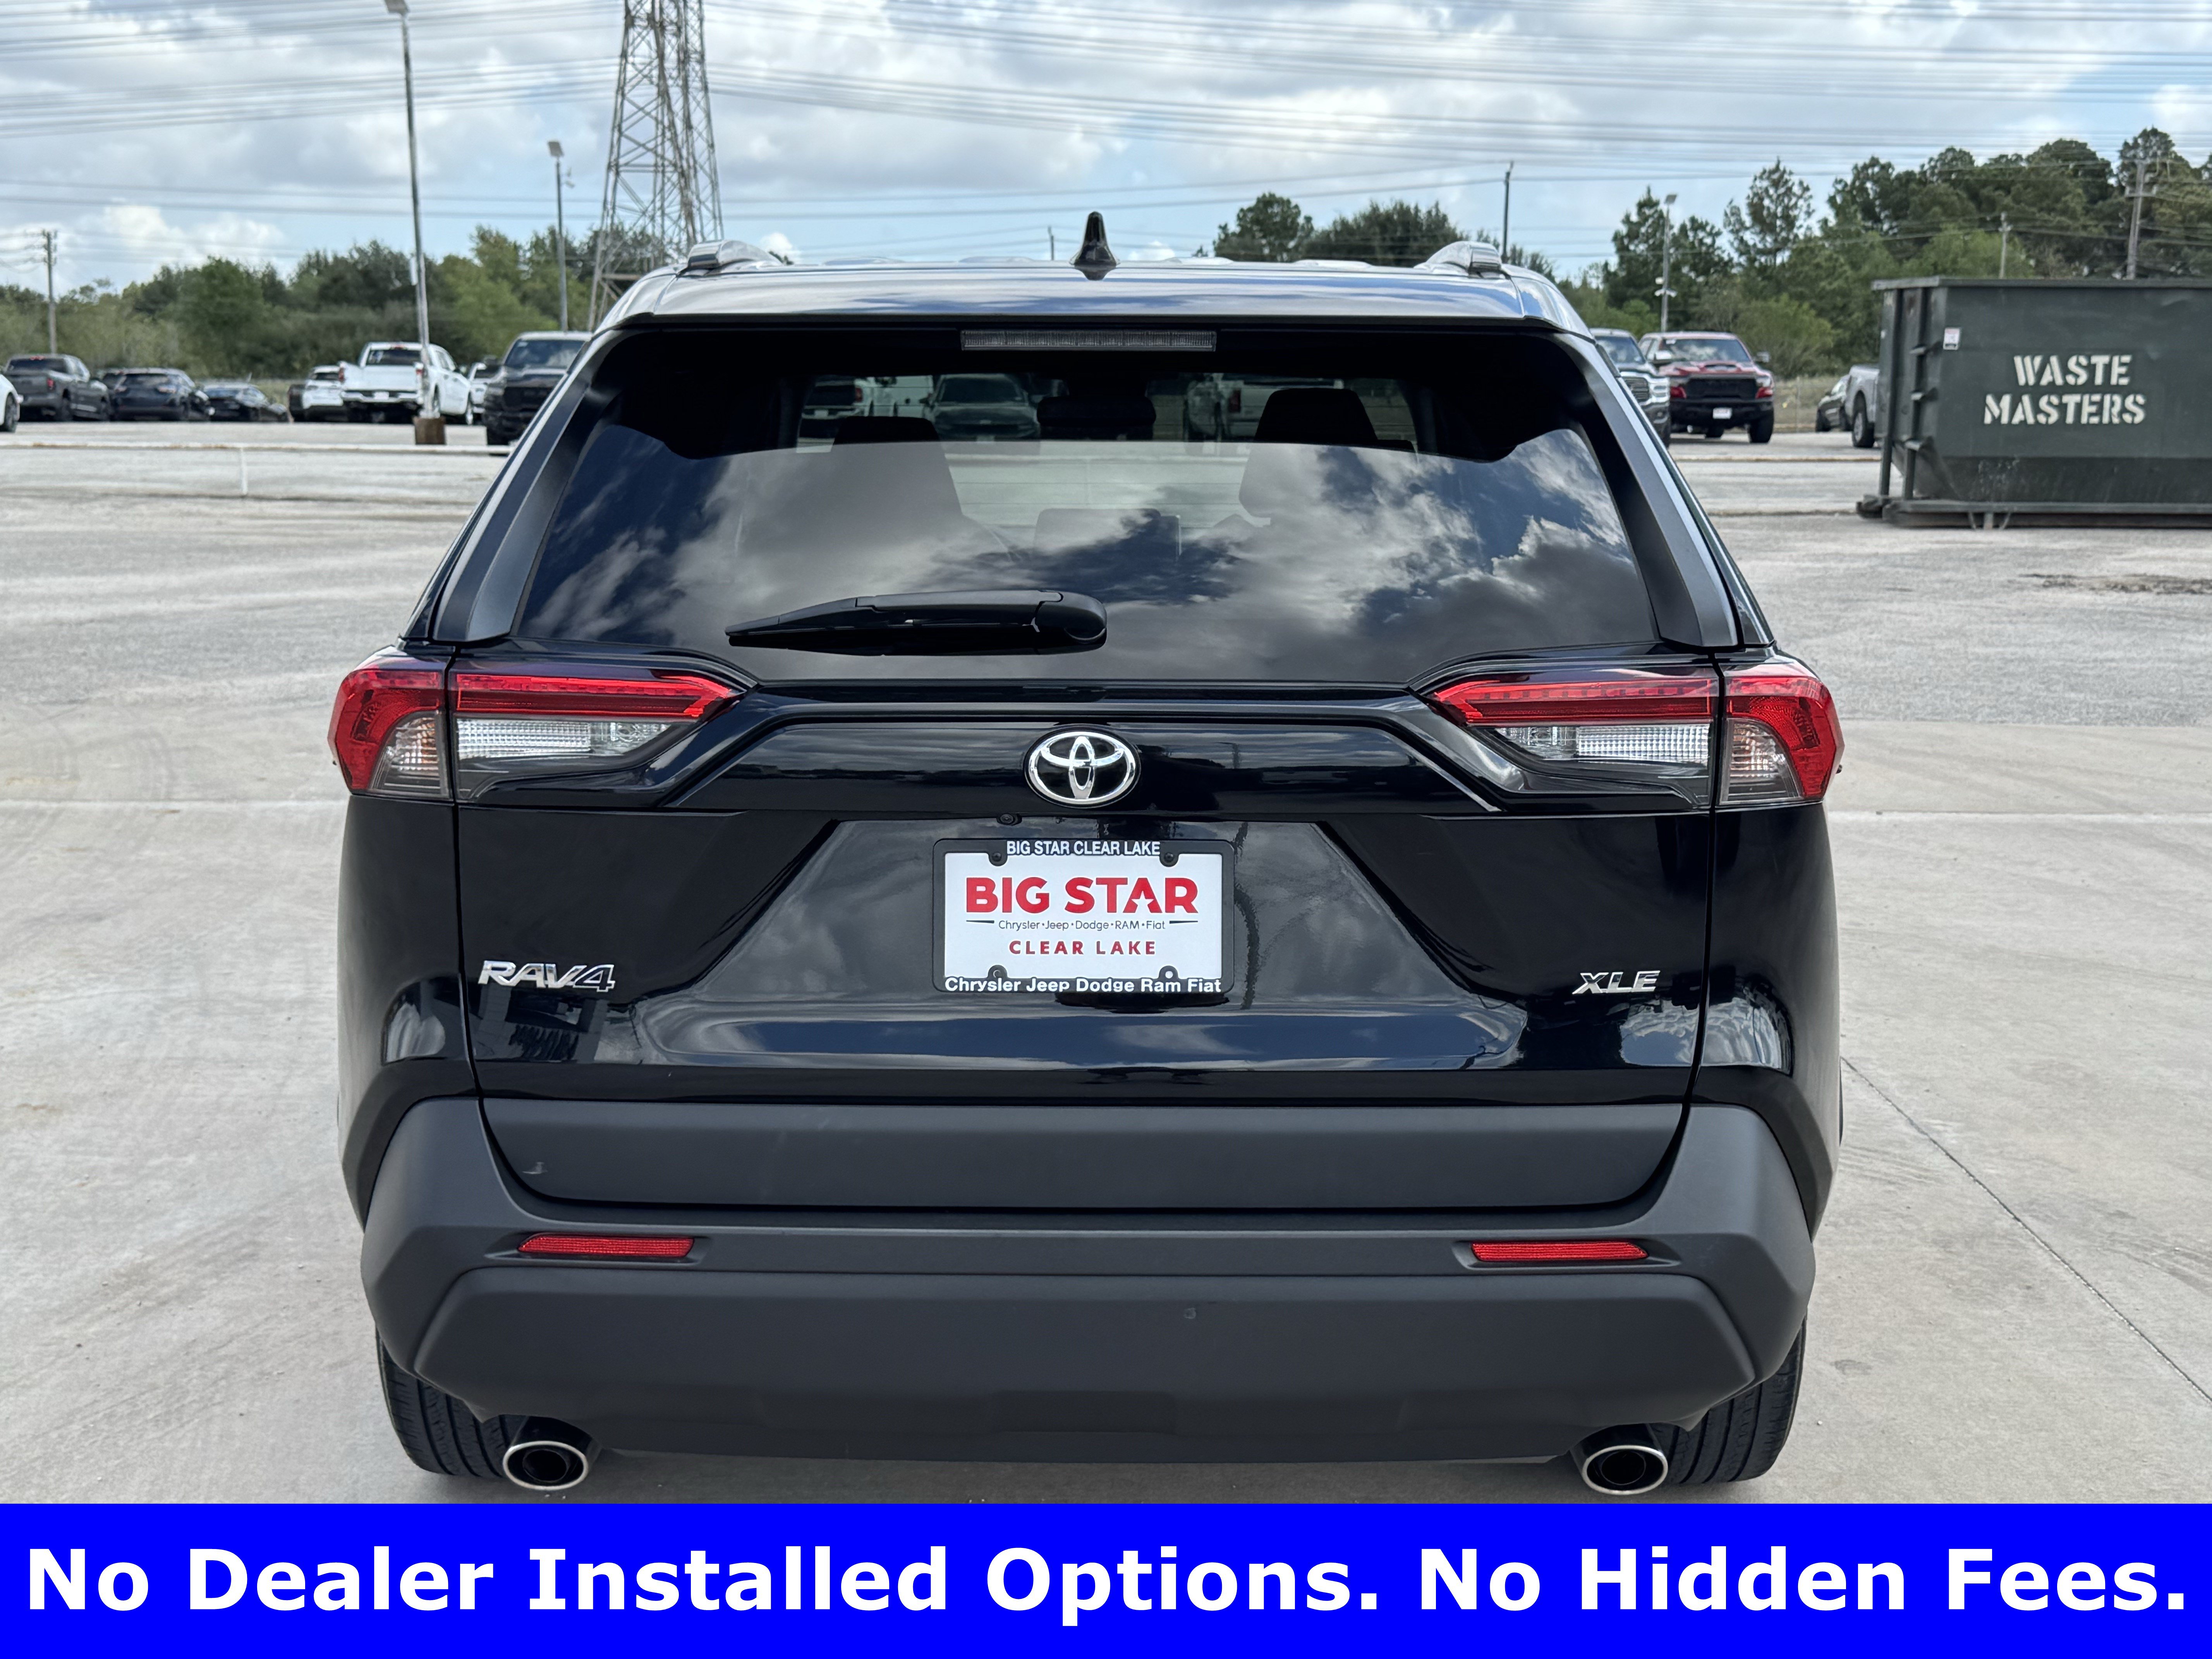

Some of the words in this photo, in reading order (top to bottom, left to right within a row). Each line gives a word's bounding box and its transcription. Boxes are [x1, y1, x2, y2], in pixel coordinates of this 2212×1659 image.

[2014, 355, 2132, 386] WASTE
[1984, 394, 2146, 424] MASTERS
[1007, 840, 1030, 855] BIG
[1034, 840, 1070, 855] STAR
[1074, 840, 1120, 855] CLEAR
[1124, 841, 1160, 855] LAKE
[966, 877, 1049, 914] BIG
[1065, 877, 1198, 914] STAR
[998, 920, 1040, 931] Chrysler
[1045, 920, 1069, 931] Jeep
[1075, 920, 1109, 931] Dodge
[1115, 921, 1139, 929] RAM
[1146, 921, 1165, 929] Fiat
[1009, 941, 1084, 955] CLEAR
[1096, 941, 1155, 955] LAKE
[478, 960, 615, 992] RAV4
[945, 977, 1021, 992] Chrysler
[1026, 978, 1070, 992] Jeep
[1076, 978, 1134, 992] Dodge
[1141, 978, 1181, 992] Ram
[1187, 979, 1221, 993] Fiat
[1572, 970, 1661, 994] XLE
